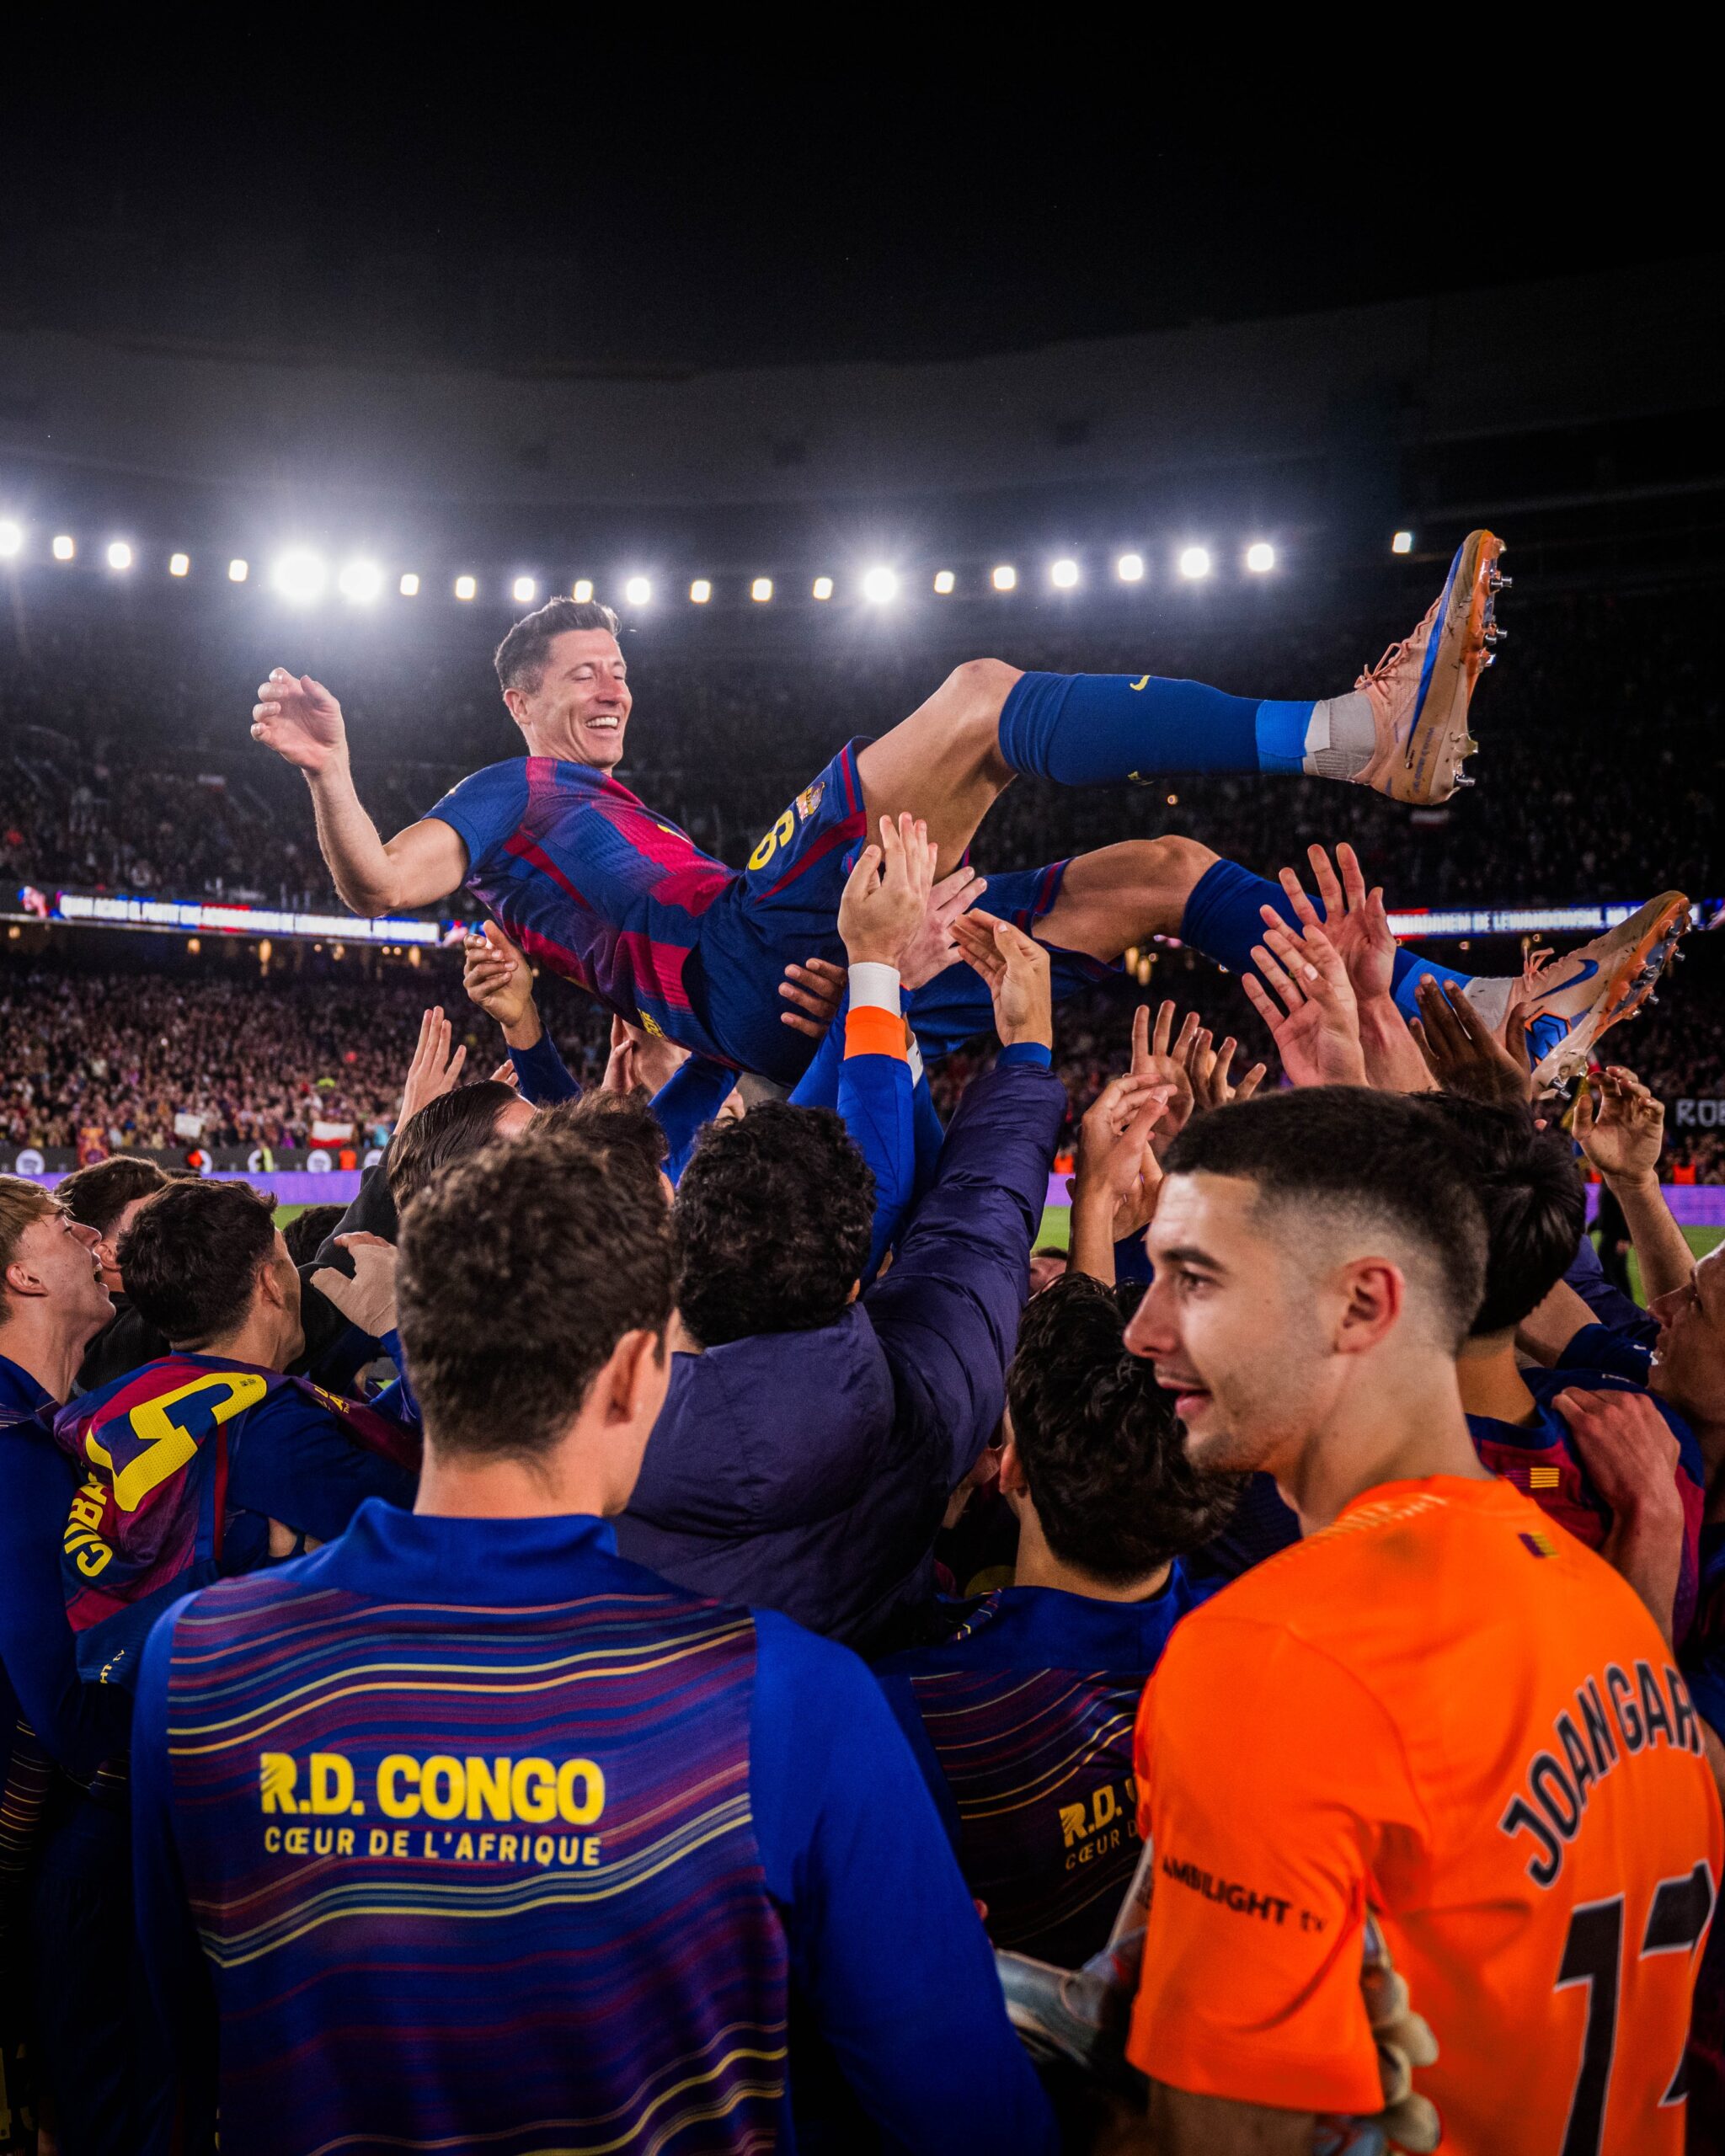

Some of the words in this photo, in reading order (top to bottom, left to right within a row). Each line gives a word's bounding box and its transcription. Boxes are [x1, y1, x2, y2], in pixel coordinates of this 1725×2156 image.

[63, 1471, 113, 1577] CUBA
[260, 1753, 365, 1816] R.D.
[376, 1753, 606, 1826] CONGO
[1059, 1784, 1123, 1848] R.D.
[264, 1826, 355, 1854] CŒUR
[369, 1828, 409, 1857] DE
